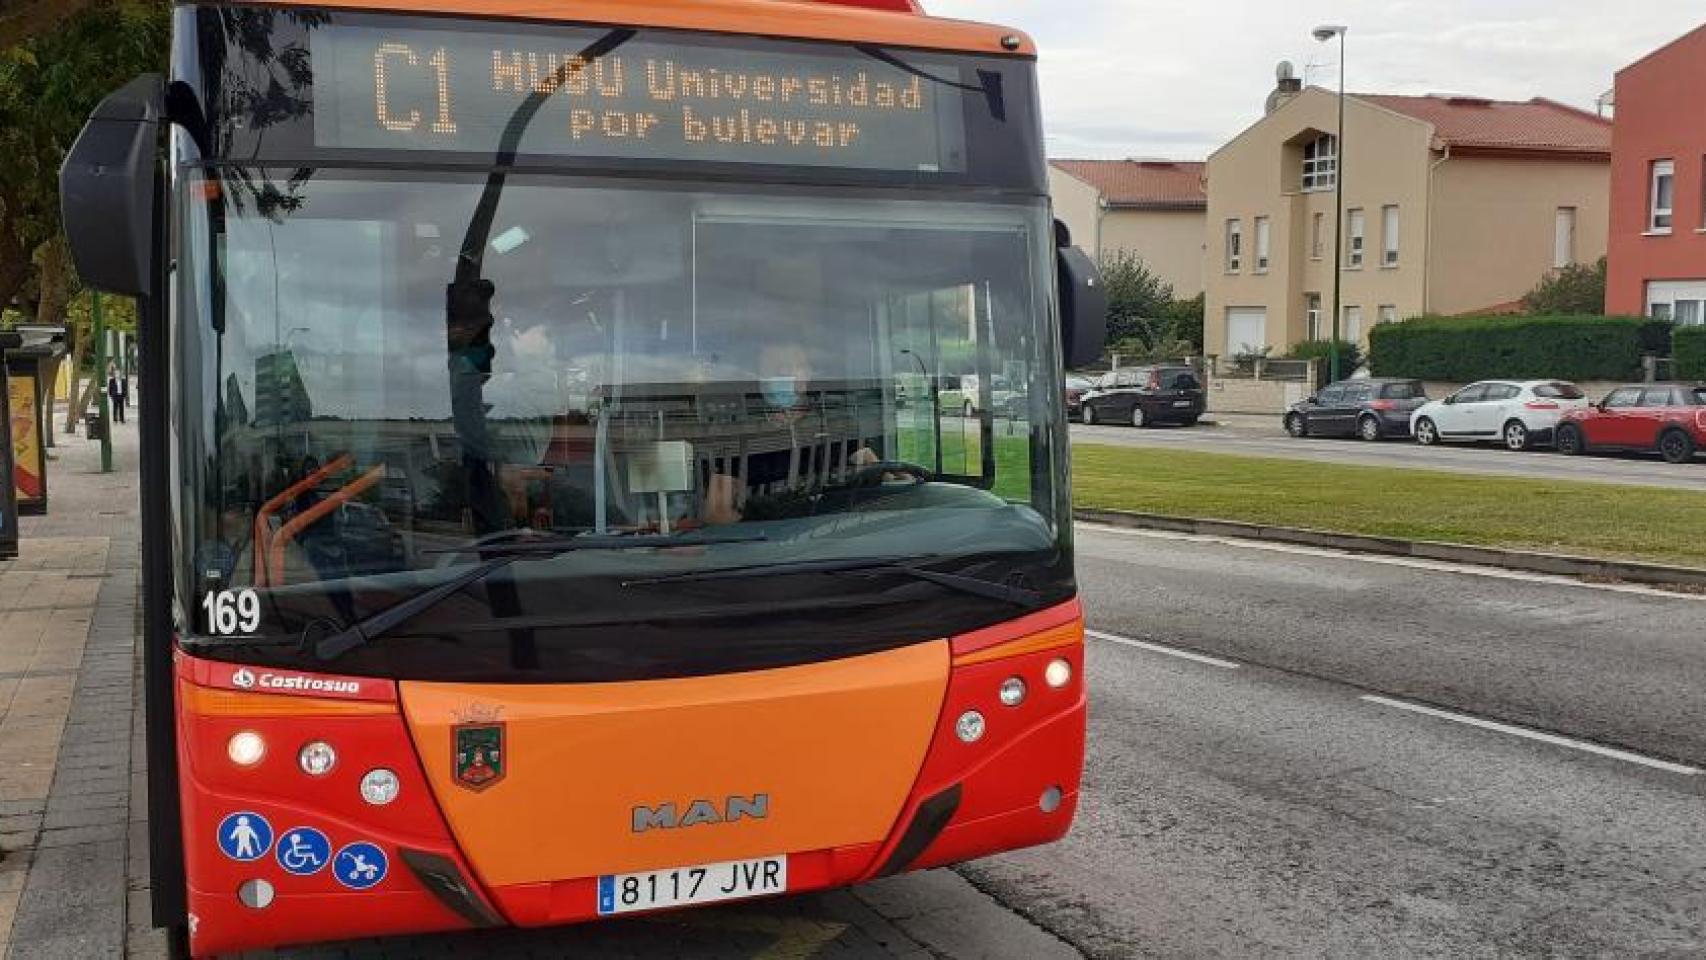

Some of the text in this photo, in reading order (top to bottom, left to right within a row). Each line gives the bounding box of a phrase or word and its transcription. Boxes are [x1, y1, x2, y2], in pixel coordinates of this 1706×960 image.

[374, 42, 457, 135] C1
[492, 49, 923, 111] HUBU Universidad
[570, 104, 862, 148] por bulevar
[202, 588, 261, 635] 169
[258, 673, 361, 694] Castrosua
[631, 793, 769, 833] MAN
[621, 859, 780, 905] 8117 JVR
